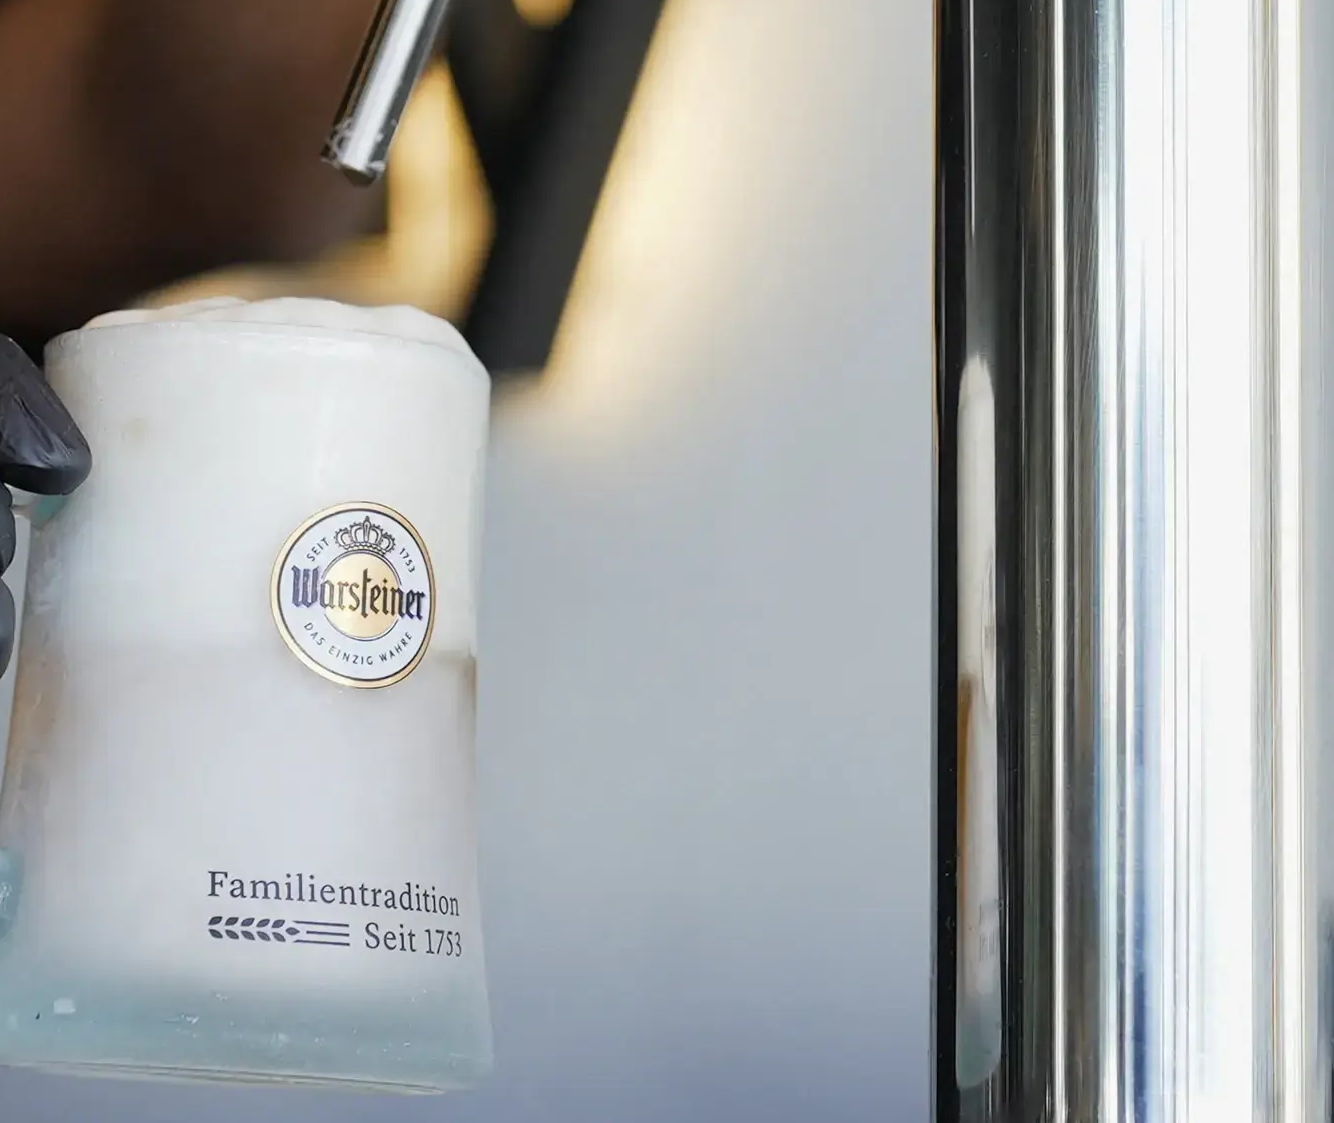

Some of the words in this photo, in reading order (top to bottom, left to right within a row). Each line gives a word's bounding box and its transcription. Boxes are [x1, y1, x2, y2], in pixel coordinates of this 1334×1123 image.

[306, 536, 330, 562] SEIT
[399, 547, 416, 574] 1753
[291, 564, 426, 621] Warsteiner
[304, 622, 326, 646] DAS
[328, 645, 374, 666] EINZIG
[378, 631, 413, 663] WAHRE
[207, 870, 460, 917] Familientradition
[364, 921, 417, 953] Seit
[424, 927, 463, 958] 1753
